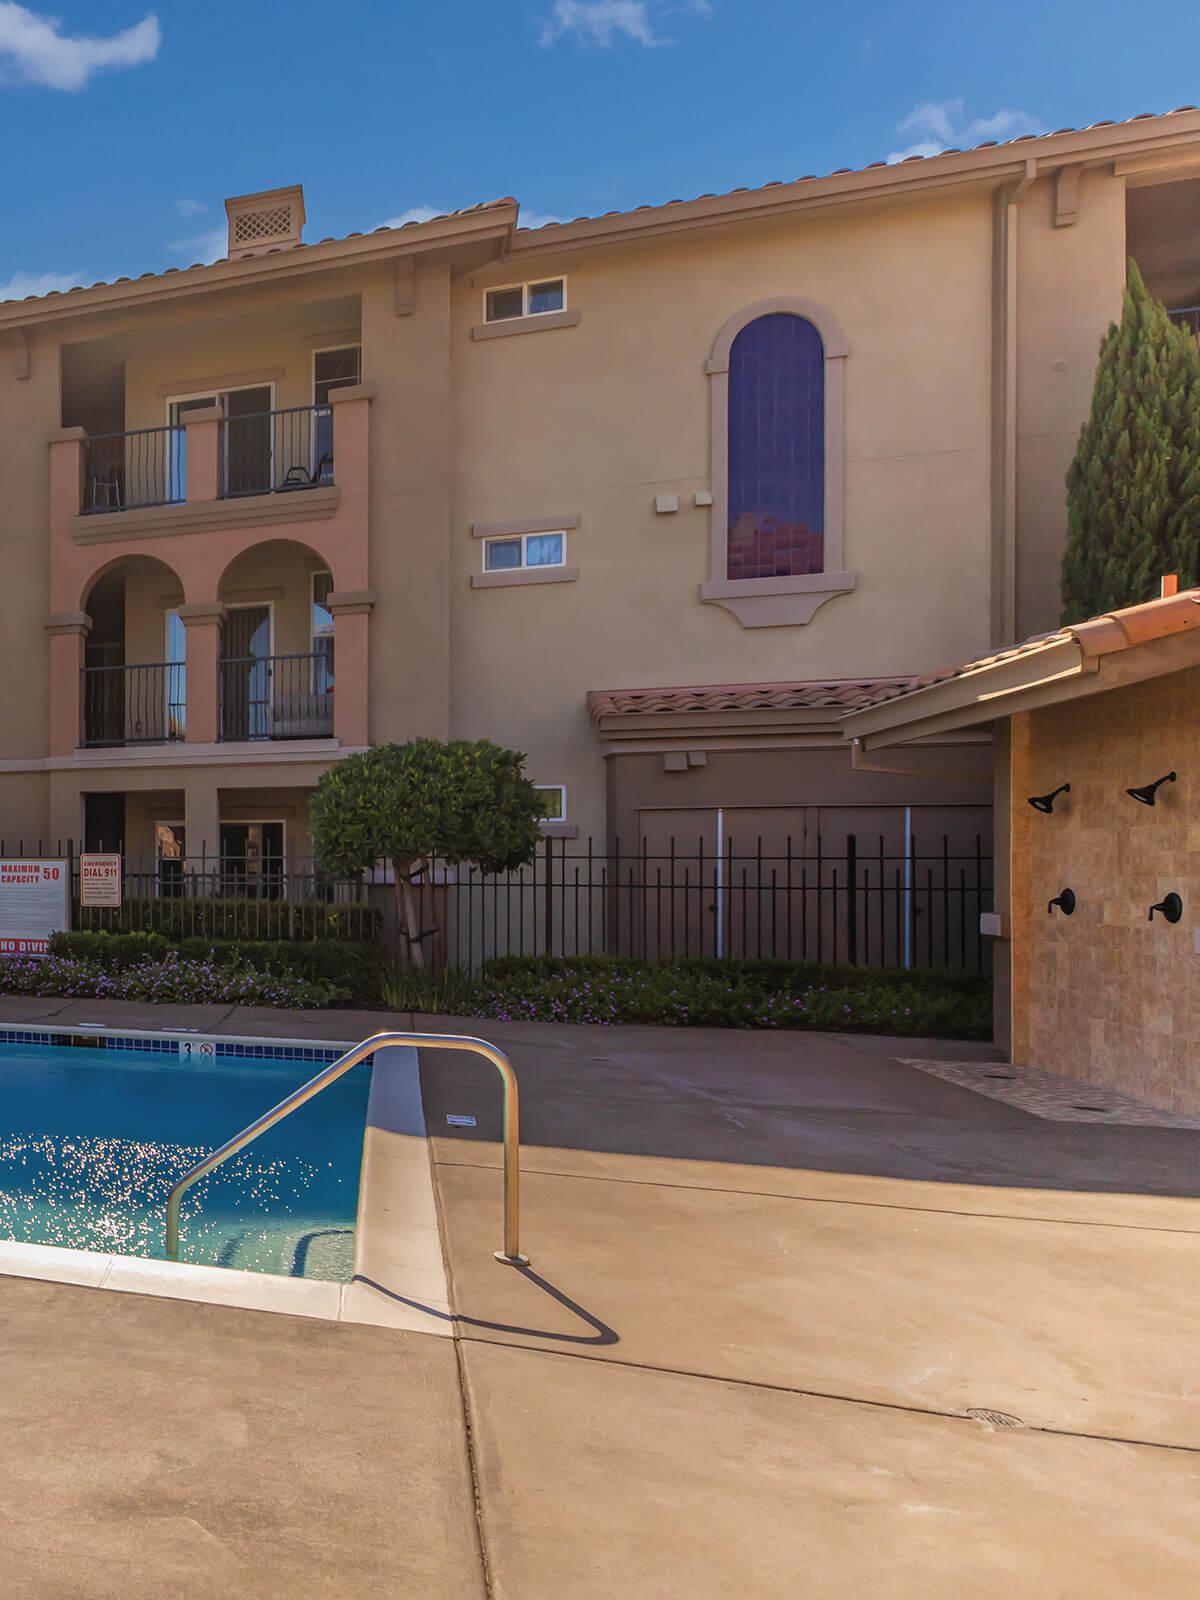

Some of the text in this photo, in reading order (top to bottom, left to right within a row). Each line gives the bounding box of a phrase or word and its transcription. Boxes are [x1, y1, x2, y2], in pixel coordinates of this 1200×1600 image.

[1, 865, 40, 873] MAXIMUM
[43, 867, 60, 880] 50
[83, 868, 117, 877] DIAL 911
[1, 875, 39, 884] CAPACITY
[0, 941, 16, 951] NO
[184, 1042, 192, 1055] 3
